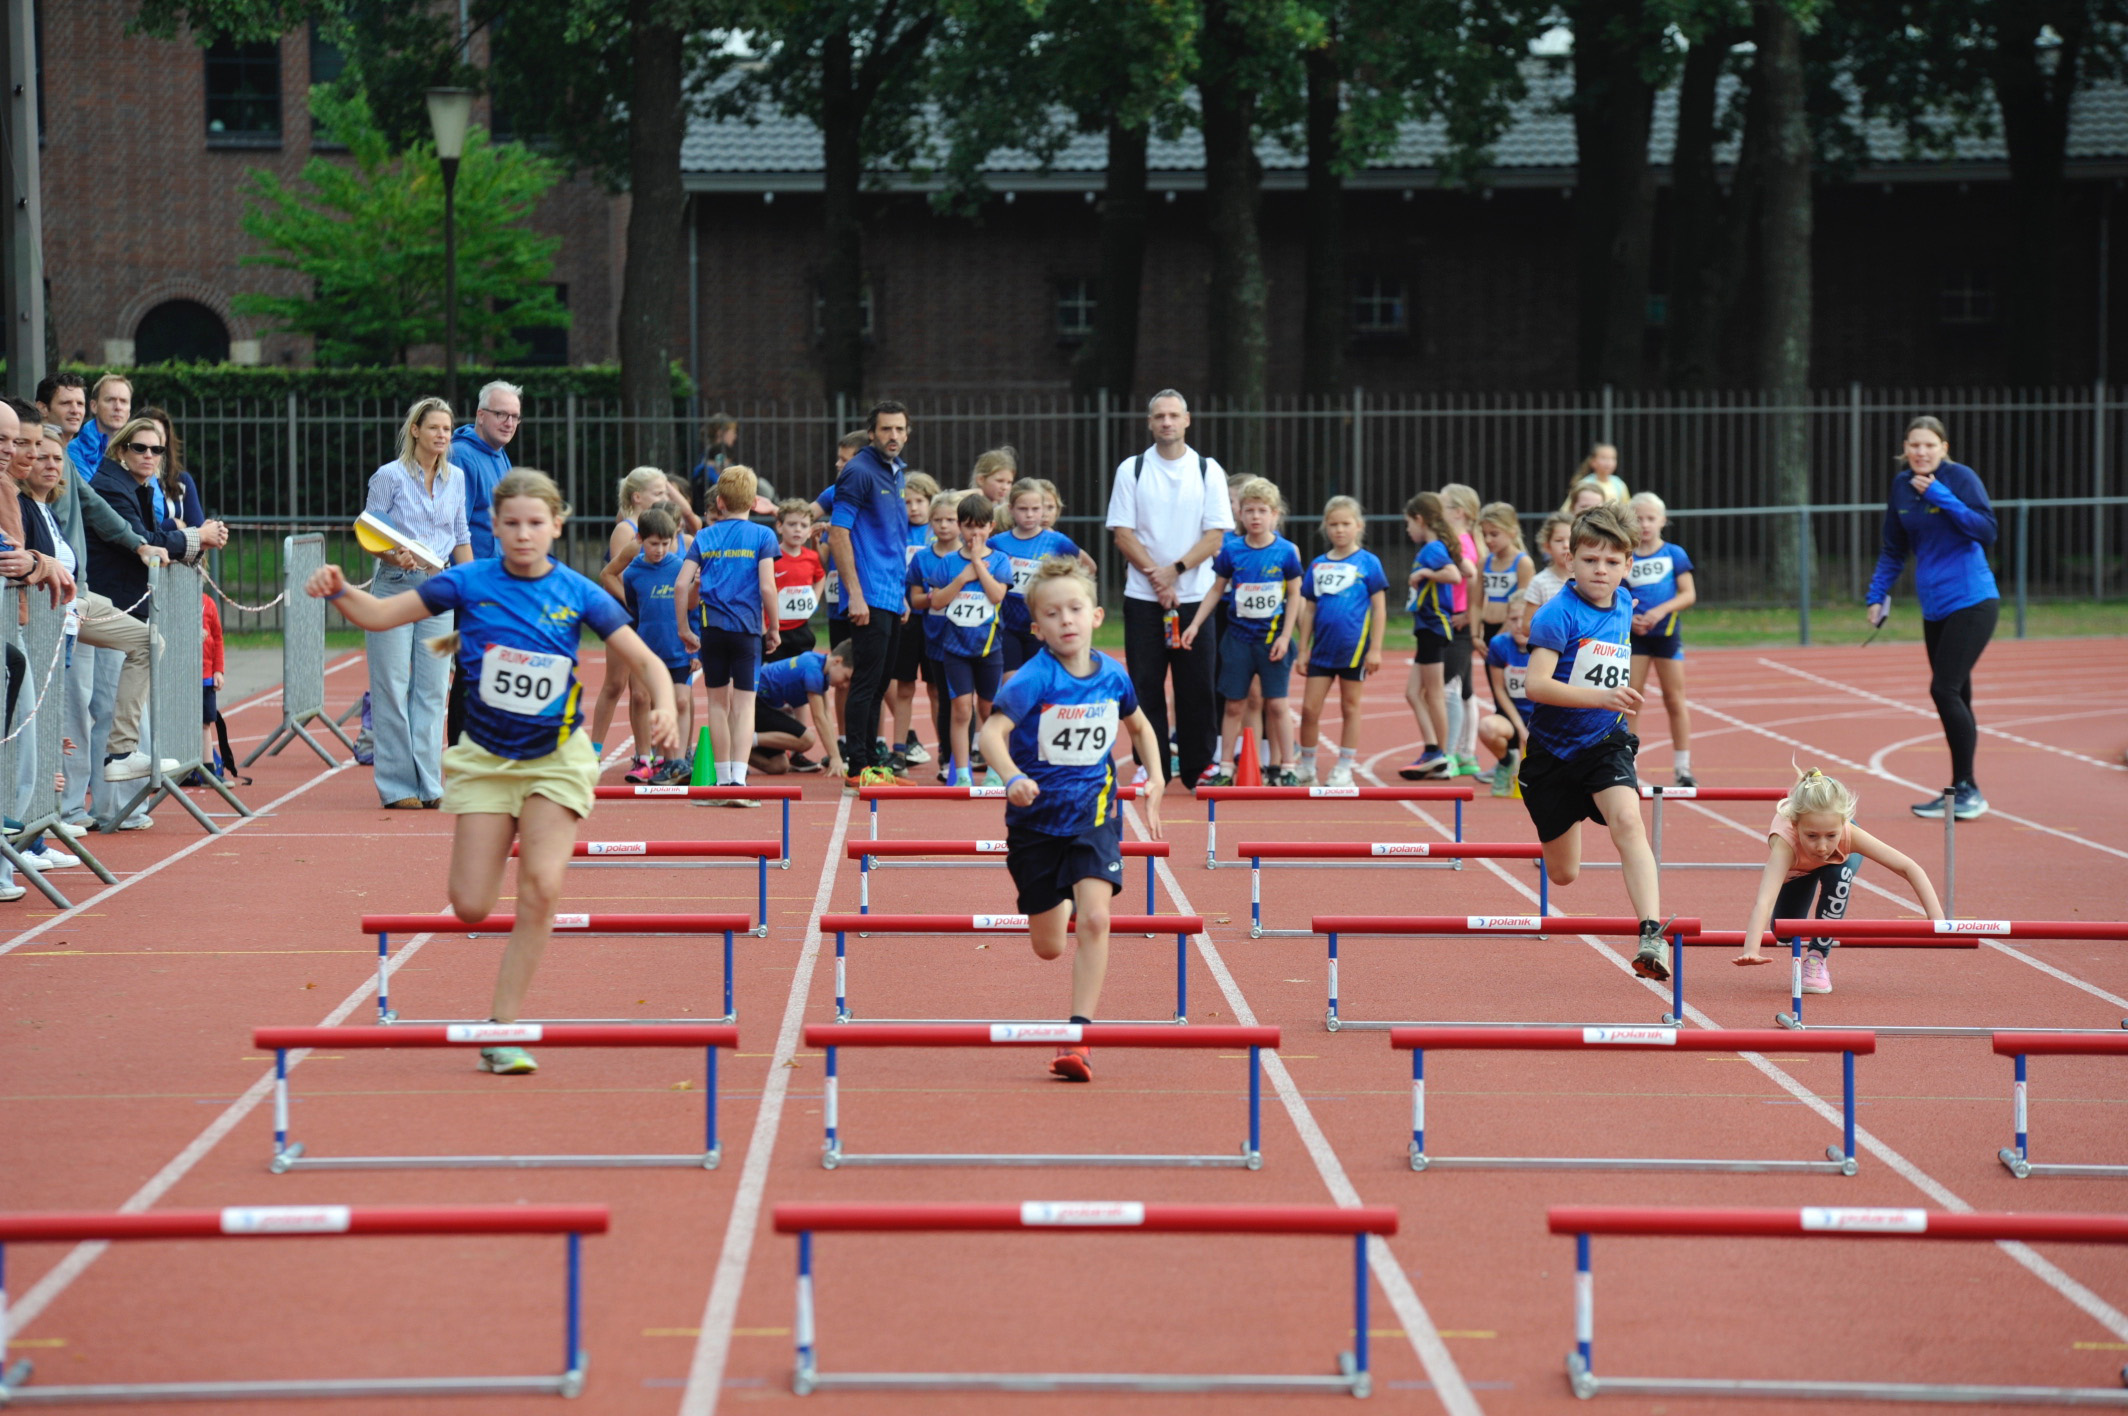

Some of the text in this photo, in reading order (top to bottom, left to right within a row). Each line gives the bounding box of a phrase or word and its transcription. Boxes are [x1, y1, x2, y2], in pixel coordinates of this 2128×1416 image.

[1631, 561, 1664, 578] 869
[1012, 571, 1032, 586] 47
[1316, 574, 1346, 587] 487
[828, 582, 839, 595] 48
[786, 597, 814, 612] 498
[1243, 595, 1277, 610] 486
[953, 603, 985, 619] 471
[1584, 663, 1630, 689] 485
[494, 669, 552, 701] 590
[1051, 726, 1107, 751] 479
[606, 844, 641, 853] polanik
[1389, 845, 1425, 854] polanik
[994, 917, 1029, 926] polani
[1488, 918, 1531, 927] polanik
[1957, 922, 2001, 931] polanik
[1611, 1028, 1664, 1040] polanik
